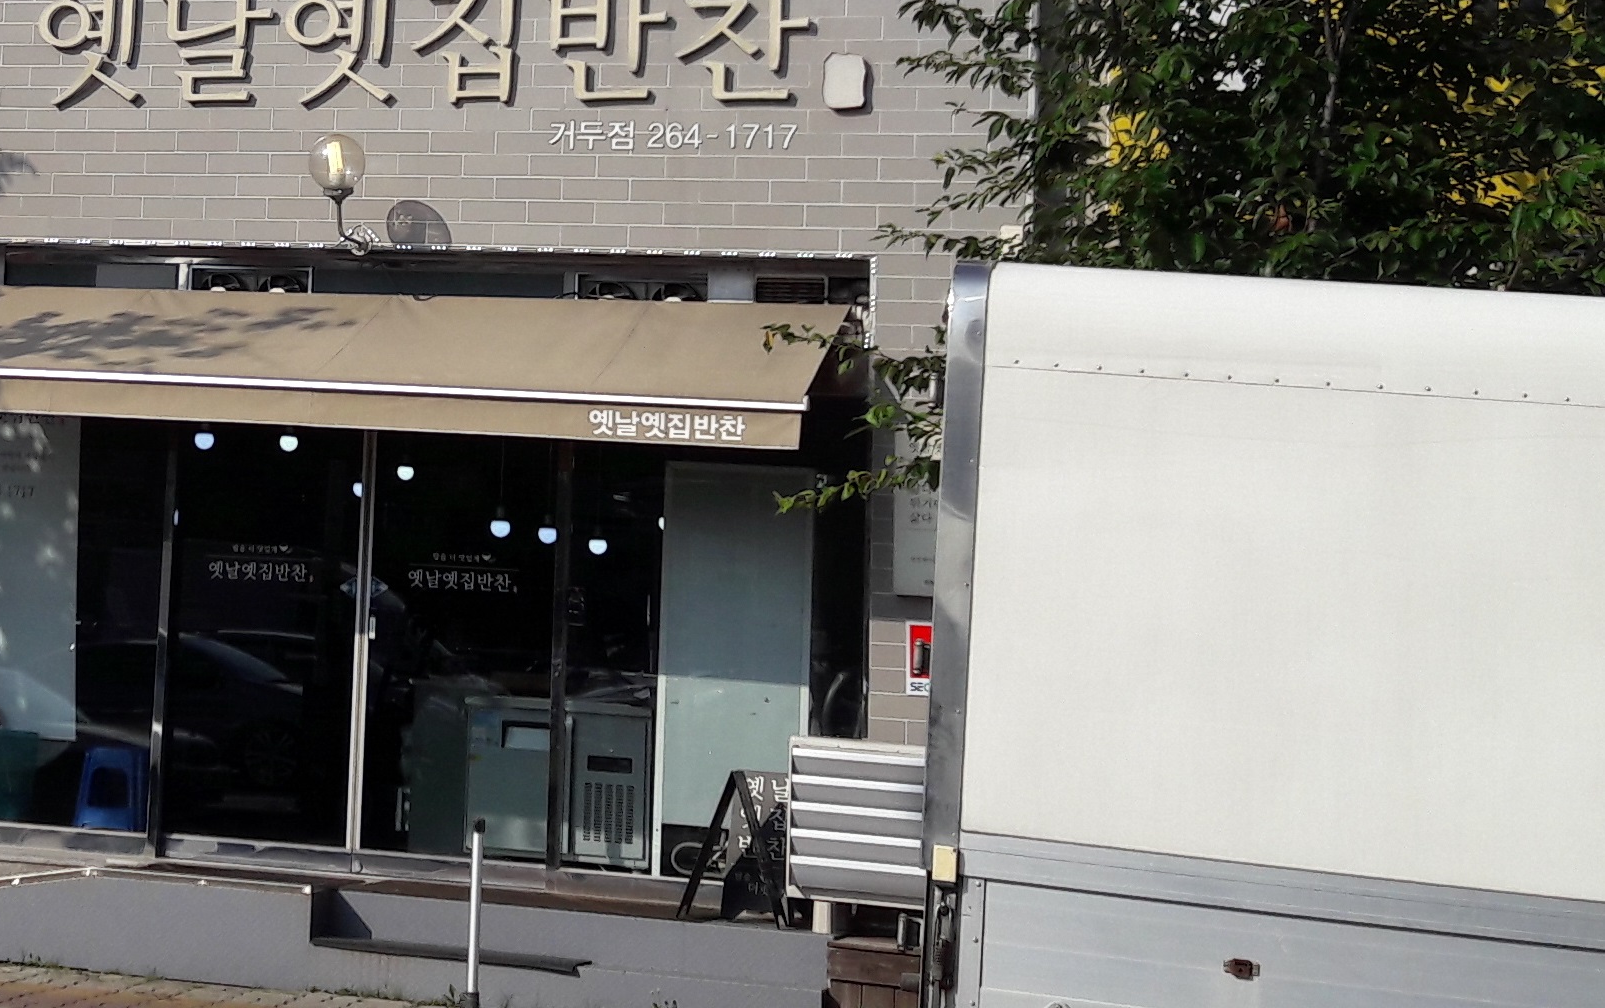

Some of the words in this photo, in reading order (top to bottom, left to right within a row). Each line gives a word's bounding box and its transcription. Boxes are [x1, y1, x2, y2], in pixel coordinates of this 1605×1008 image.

[548, 120, 635, 150] 거두점
[646, 122, 798, 150] 264-1717
[588, 409, 746, 442] 옛날옛집반찬
[408, 569, 512, 593] 옛날옛집반찬
[910, 681, 931, 692] SEC
